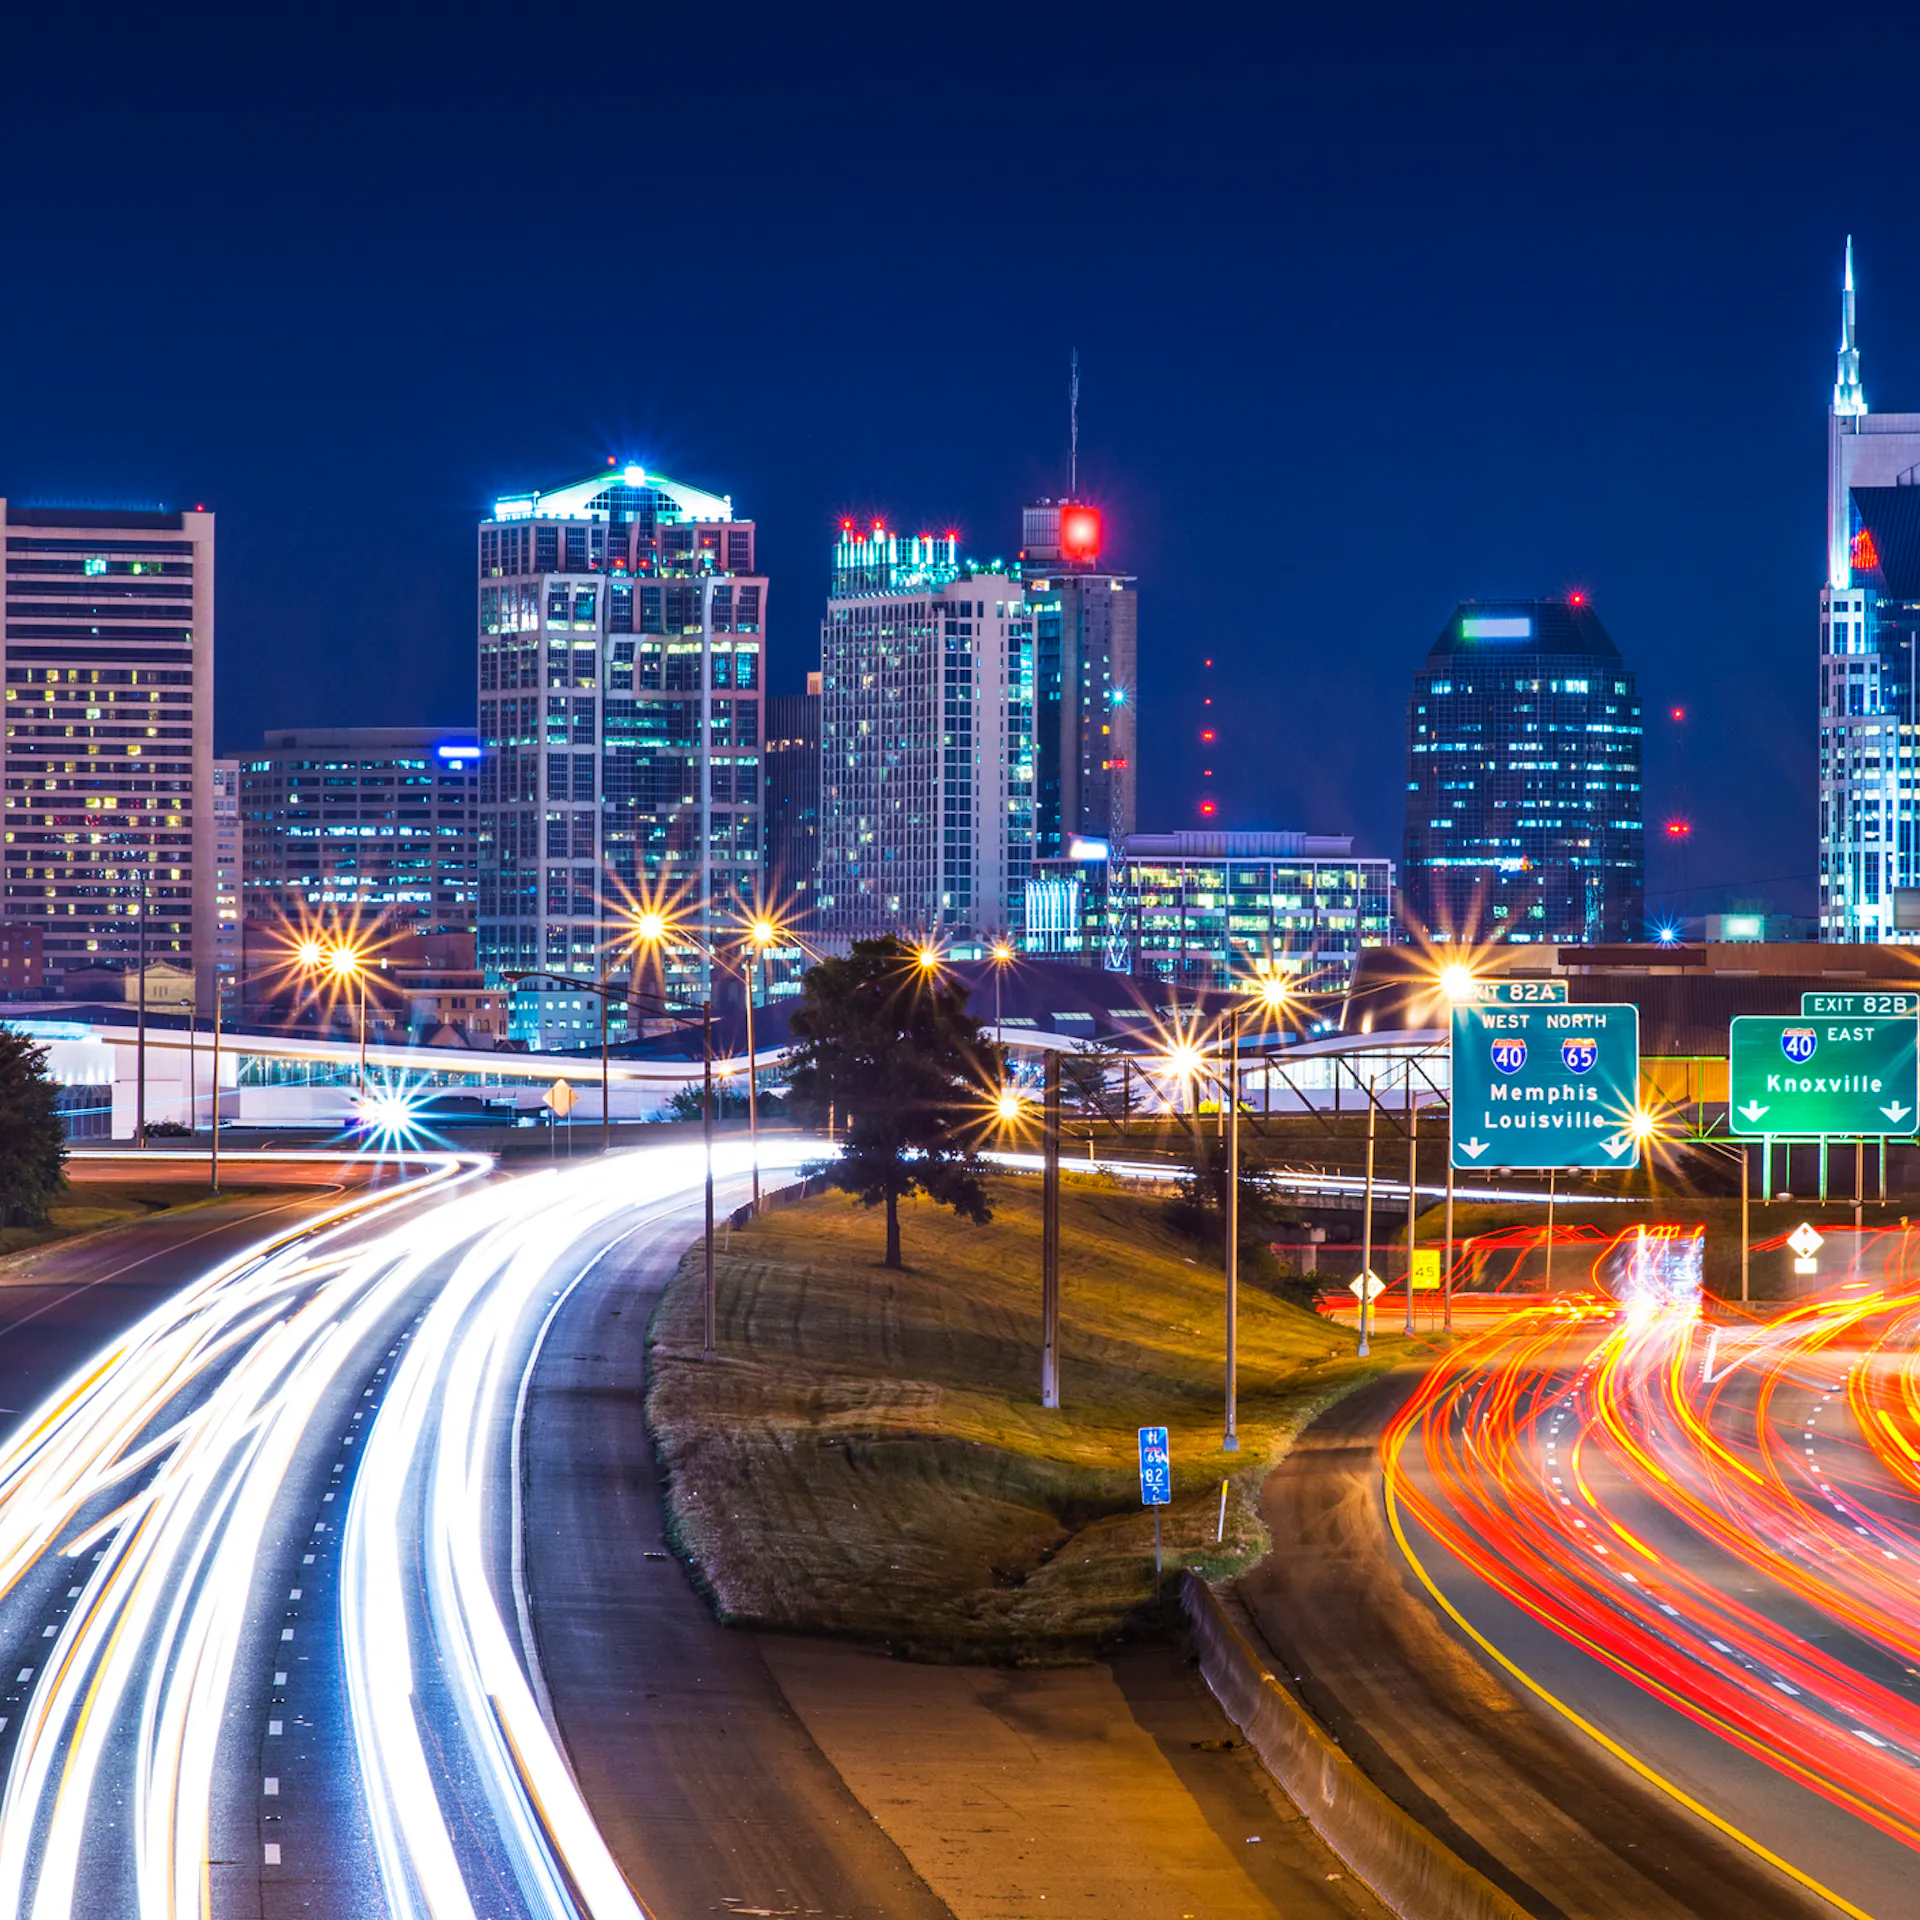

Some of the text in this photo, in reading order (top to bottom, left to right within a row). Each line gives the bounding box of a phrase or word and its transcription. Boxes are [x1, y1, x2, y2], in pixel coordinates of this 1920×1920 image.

[1464, 984, 1556, 1001] XIT 82A
[1814, 996, 1907, 1014] EXIT 82B
[1481, 1013, 1607, 1029] WEST NORTH
[1785, 1027, 1875, 1057] 40 EAST
[1496, 1047, 1593, 1067] 40 65
[1766, 1074, 1882, 1093] Knoxville
[1490, 1083, 1599, 1105] Memphis
[1484, 1111, 1605, 1129] Louisville
[1415, 1266, 1435, 1277] 45
[1145, 1468, 1163, 1483] 82
